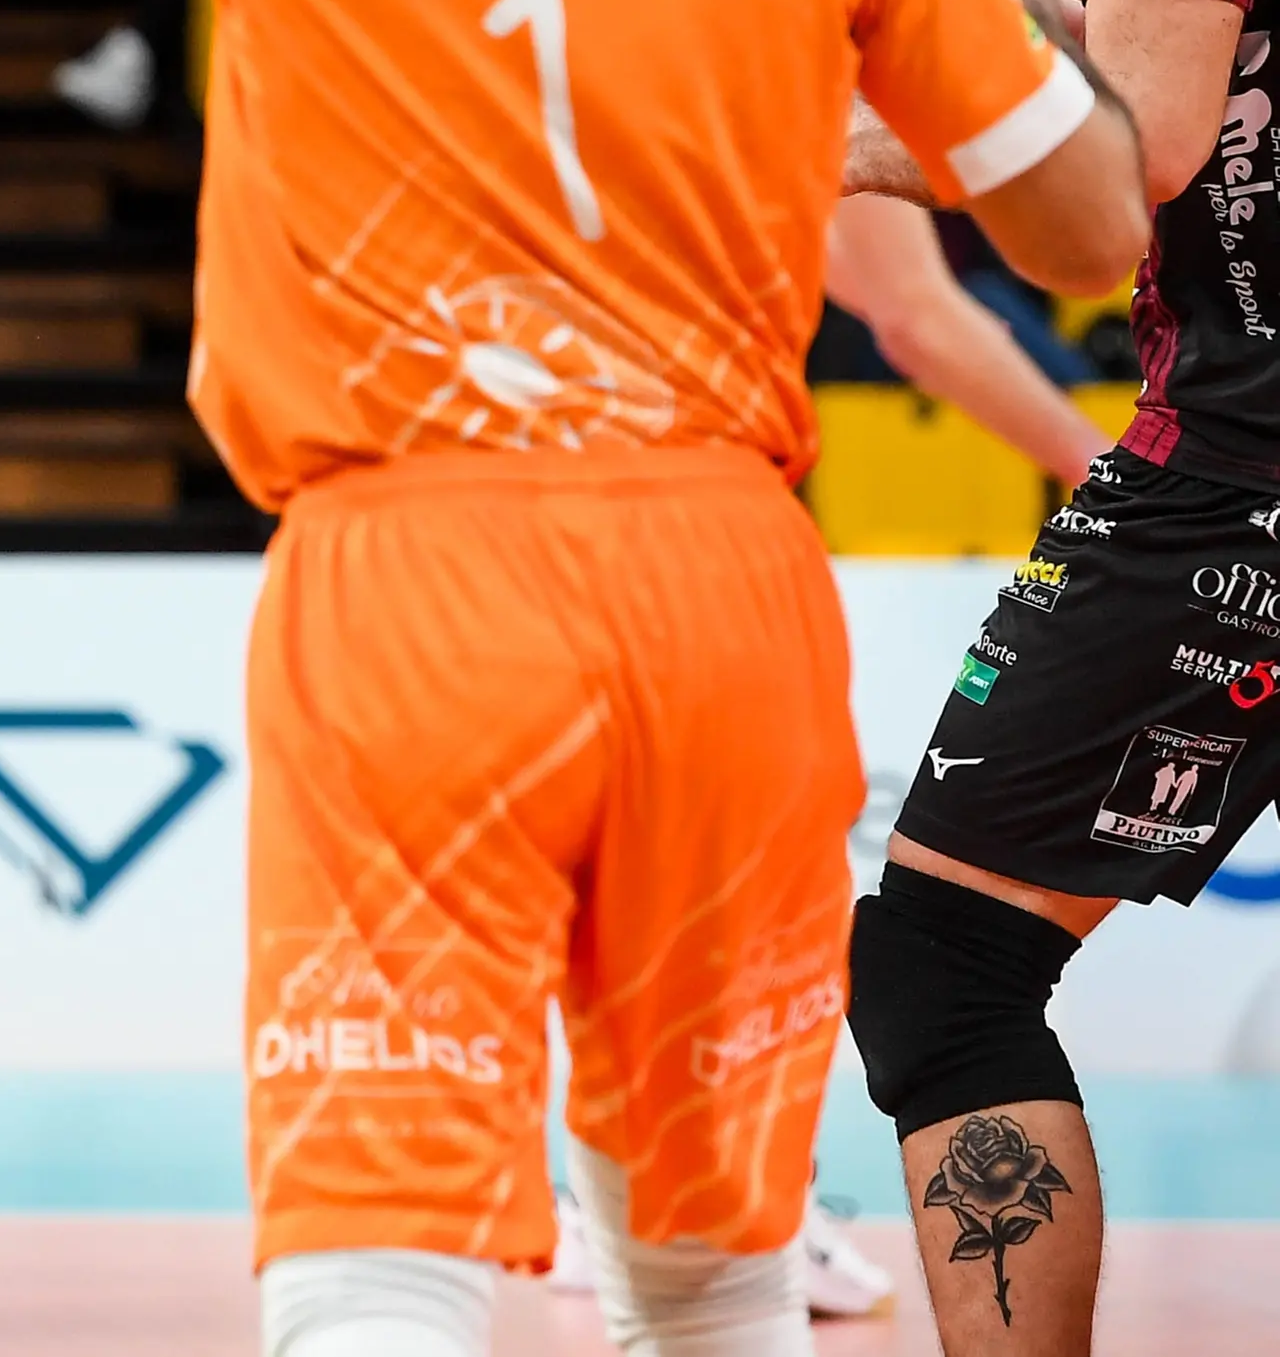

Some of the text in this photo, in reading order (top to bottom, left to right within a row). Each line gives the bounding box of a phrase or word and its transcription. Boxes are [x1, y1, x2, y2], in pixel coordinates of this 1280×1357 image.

[1200, 182, 1230, 223] per
[1225, 259, 1278, 342] Sport
[1216, 610, 1280, 640] GASTRO
[1169, 658, 1236, 686] SERVIC
[1146, 729, 1233, 755] SUPERERCATI
[1109, 816, 1201, 843] PLUTINO
